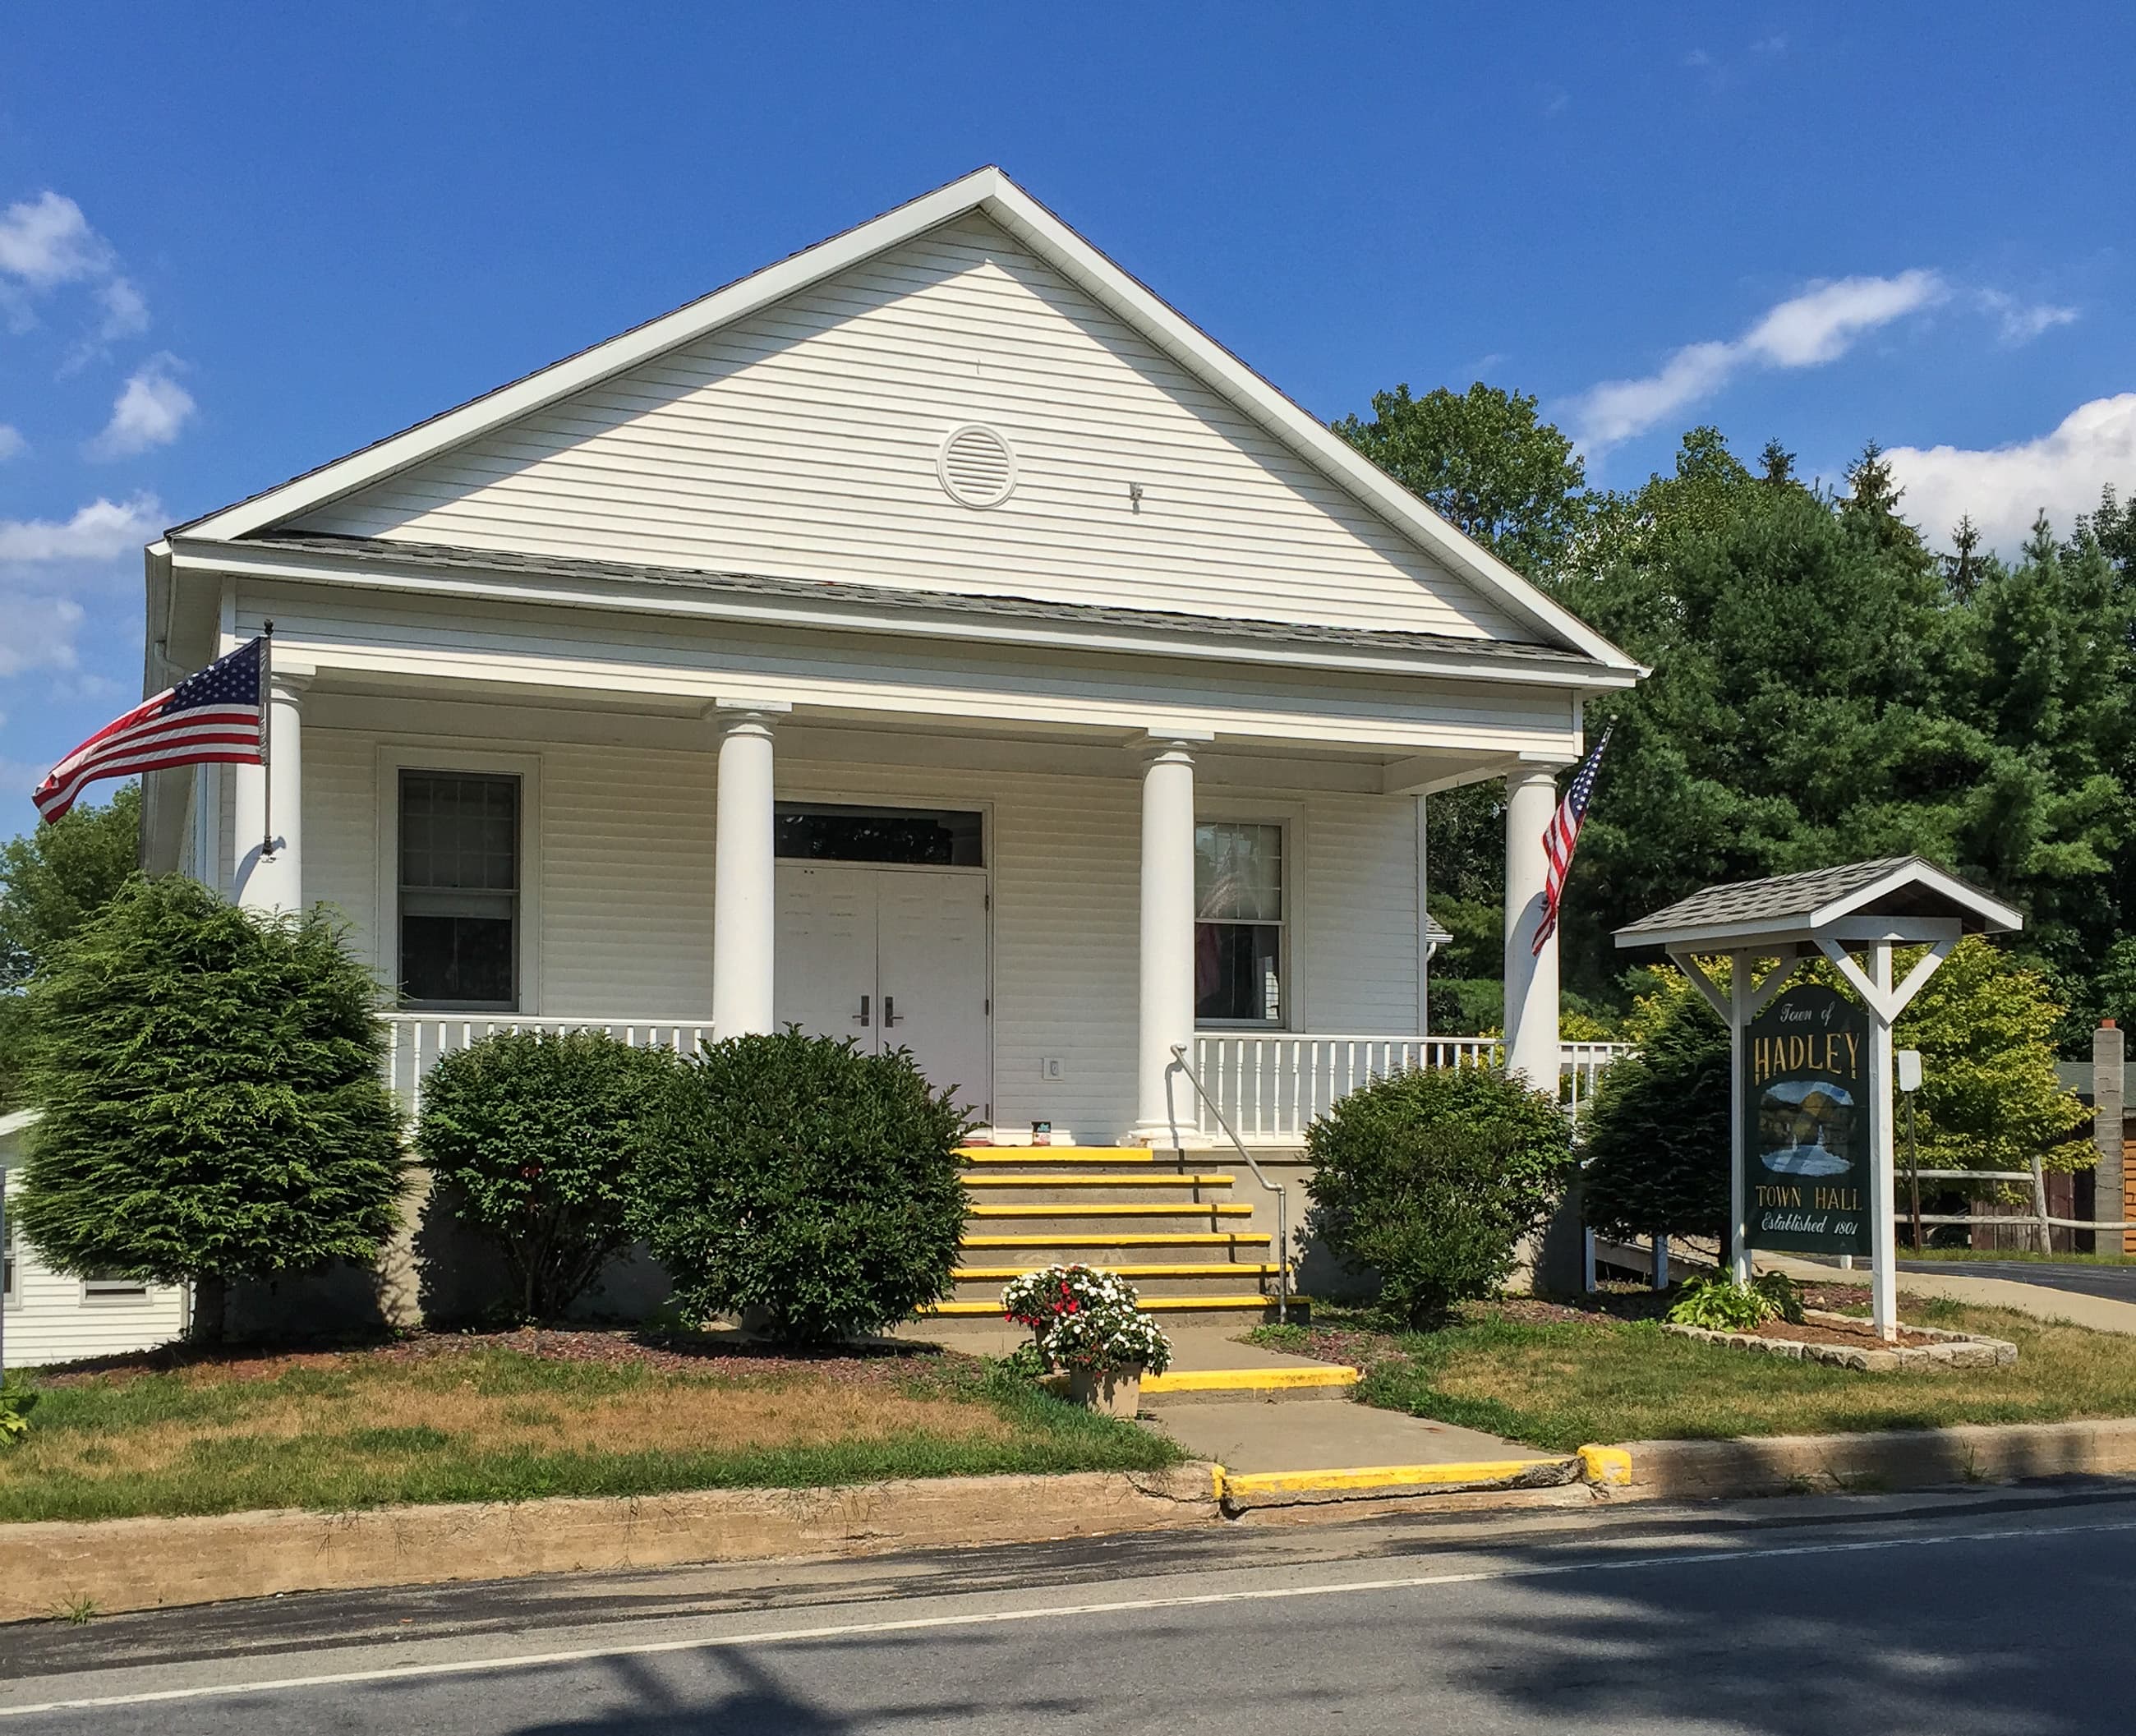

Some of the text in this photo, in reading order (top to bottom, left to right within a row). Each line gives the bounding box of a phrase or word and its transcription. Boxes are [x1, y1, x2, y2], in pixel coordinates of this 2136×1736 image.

[1780, 1001, 1835, 1026] Town of
[1754, 1031, 1860, 1086] HADLEY
[1755, 1185, 1862, 1211] TOWN HALL
[1761, 1211, 1858, 1235] Established 1801
